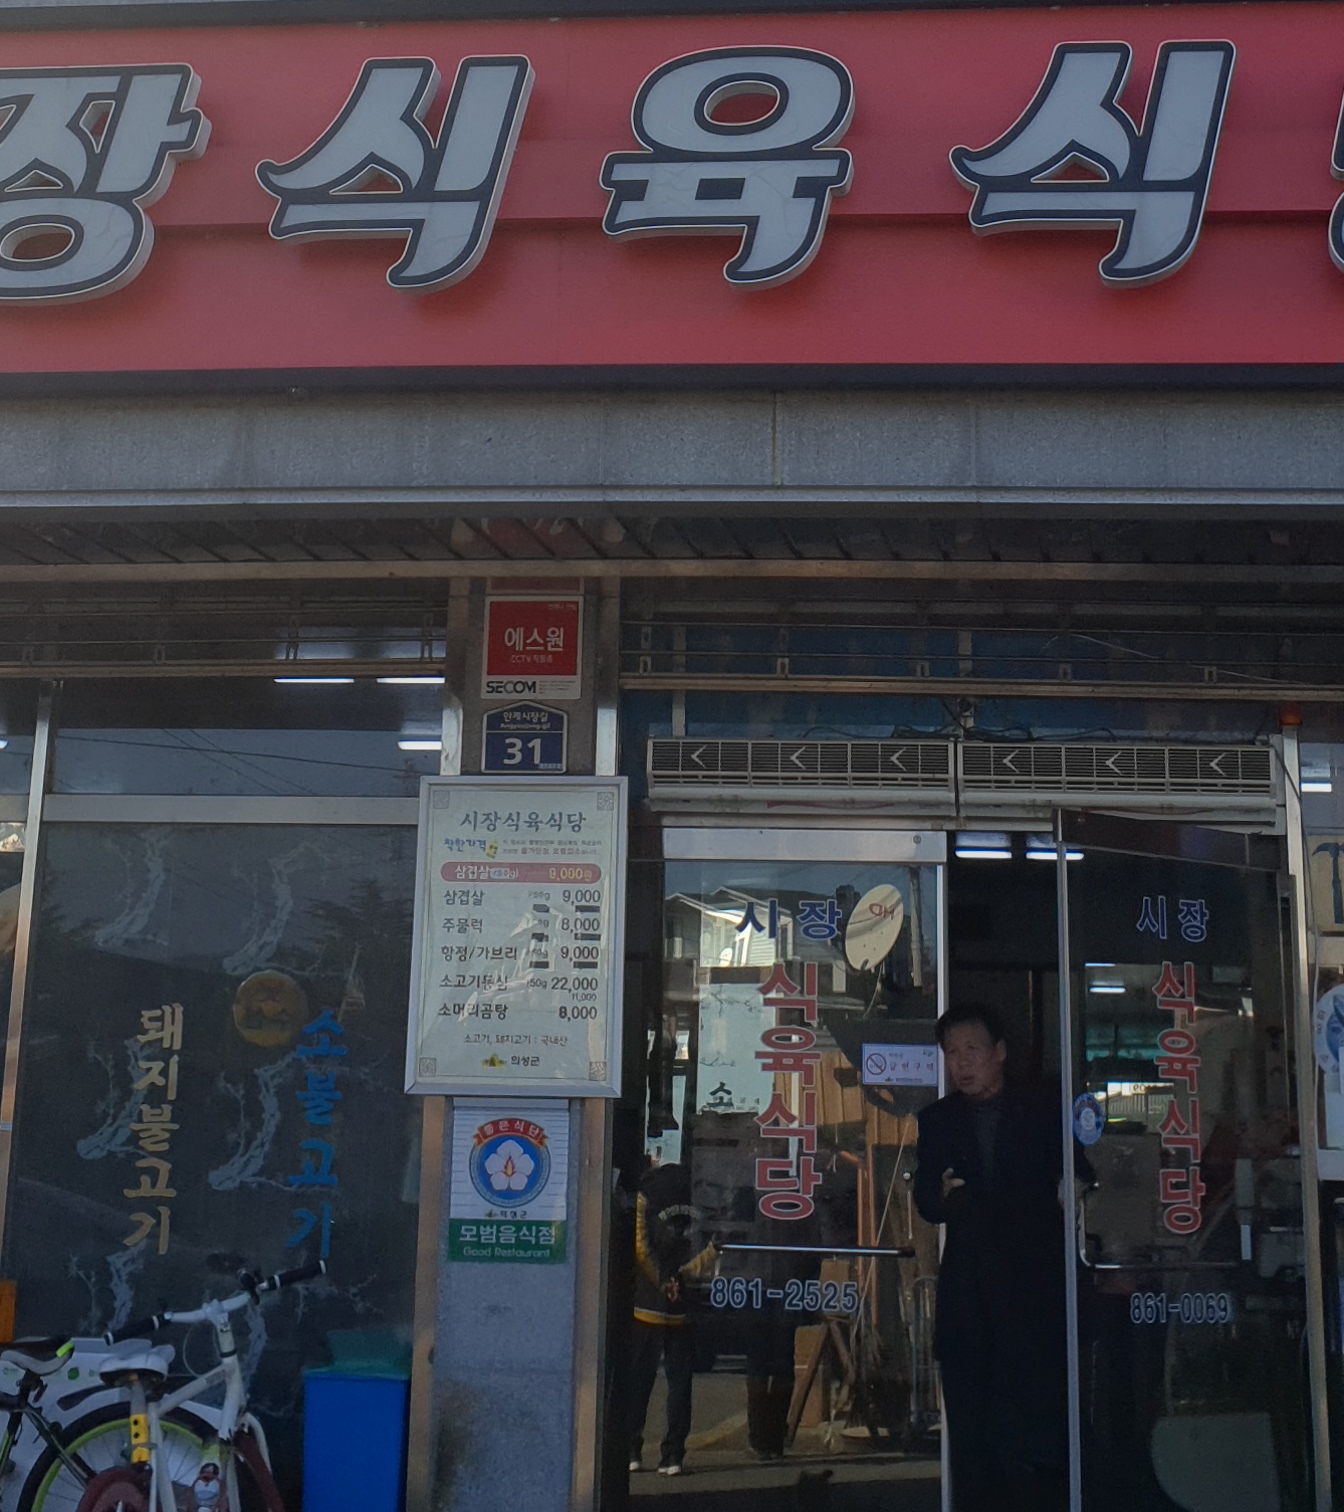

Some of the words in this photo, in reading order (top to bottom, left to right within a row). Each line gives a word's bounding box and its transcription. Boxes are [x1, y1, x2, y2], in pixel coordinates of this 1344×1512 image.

[504, 626, 564, 652] 에스원
[486, 680, 536, 694] SECOM
[503, 737, 542, 765] 31
[460, 810, 587, 834] 시장식육식당
[444, 838, 487, 853] 착한가격
[443, 889, 484, 906] 삼겹살
[562, 889, 601, 906] 9,000
[442, 917, 484, 934] 주물럭
[561, 917, 600, 934] 8,000
[735, 898, 843, 941] 시장
[1137, 895, 1209, 944] 시장
[441, 945, 518, 962] 항정/가브리
[560, 946, 599, 961] 9,000
[551, 976, 598, 993] 22,000
[438, 1003, 509, 1021] 소머리곰탕
[559, 1006, 598, 1022] 8,000
[540, 1034, 568, 1047] 국내산
[511, 1056, 540, 1067] 의성군
[754, 961, 822, 1221] 식육식당
[1152, 960, 1207, 1235] 식육식당
[122, 1002, 184, 1256] 돼지불고기
[285, 1008, 349, 1259] 소불고기
[459, 1224, 556, 1245] 모범음식점
[463, 1246, 491, 1257] Good
[494, 1248, 551, 1258] Restaurant
[710, 1276, 859, 1313] 861-2525
[1130, 1292, 1231, 1325] 861-0069
